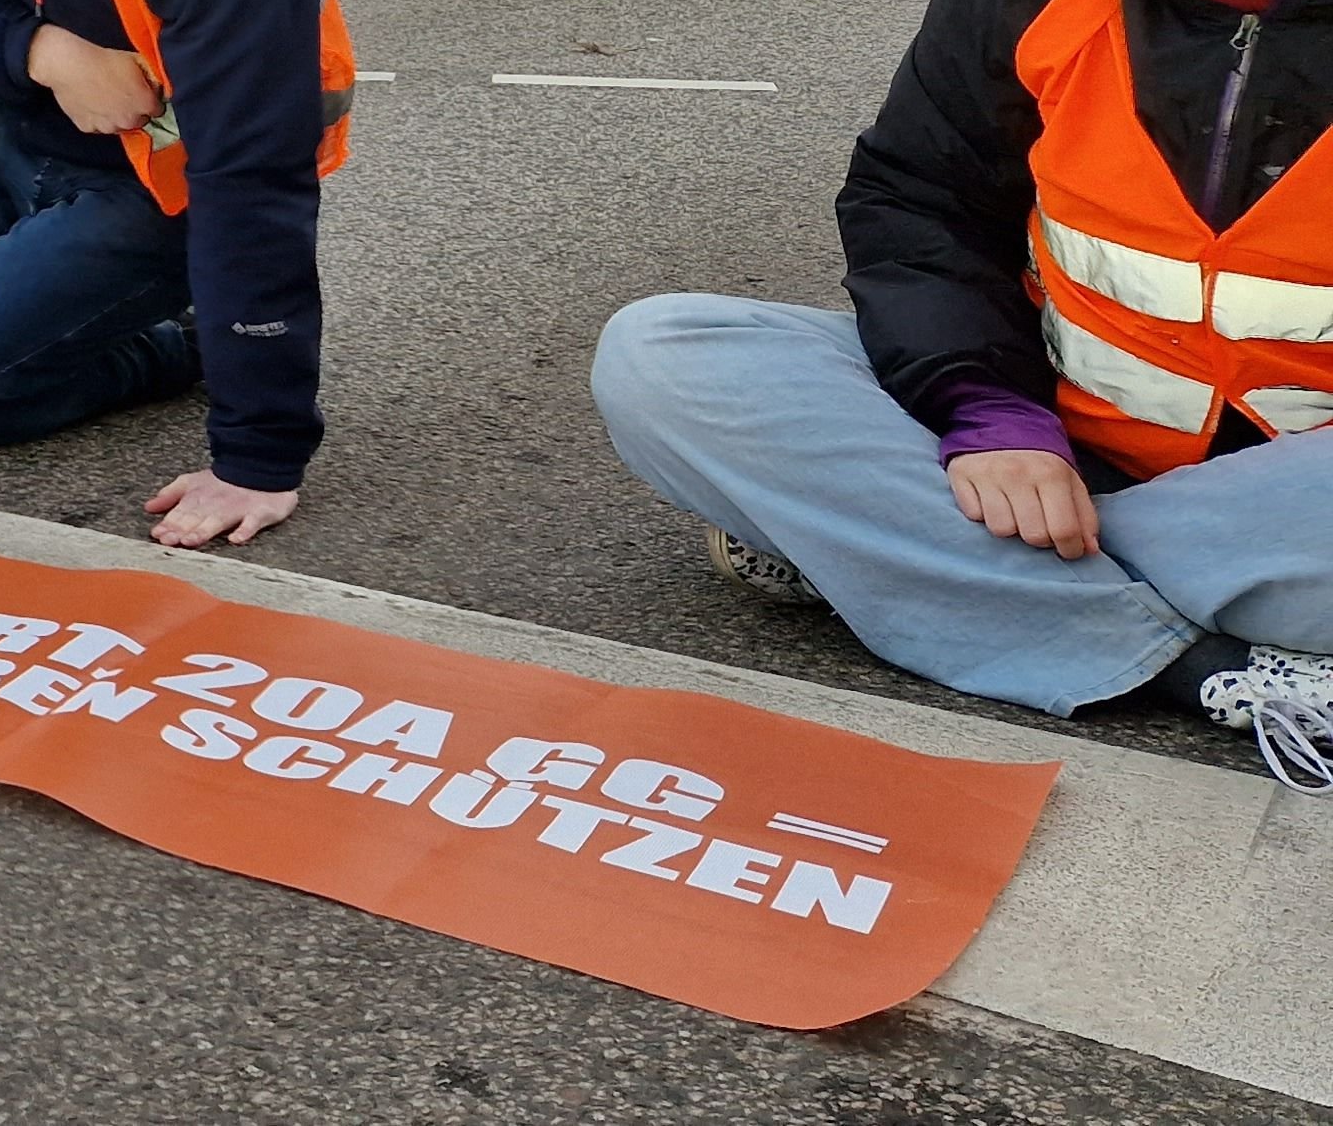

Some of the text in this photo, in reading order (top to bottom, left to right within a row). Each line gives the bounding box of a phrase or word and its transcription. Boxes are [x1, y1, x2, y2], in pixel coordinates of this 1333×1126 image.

[153, 653, 454, 759] 20A
[485, 735, 726, 822] GG
[159, 708, 893, 935] SCHÜTZEN
